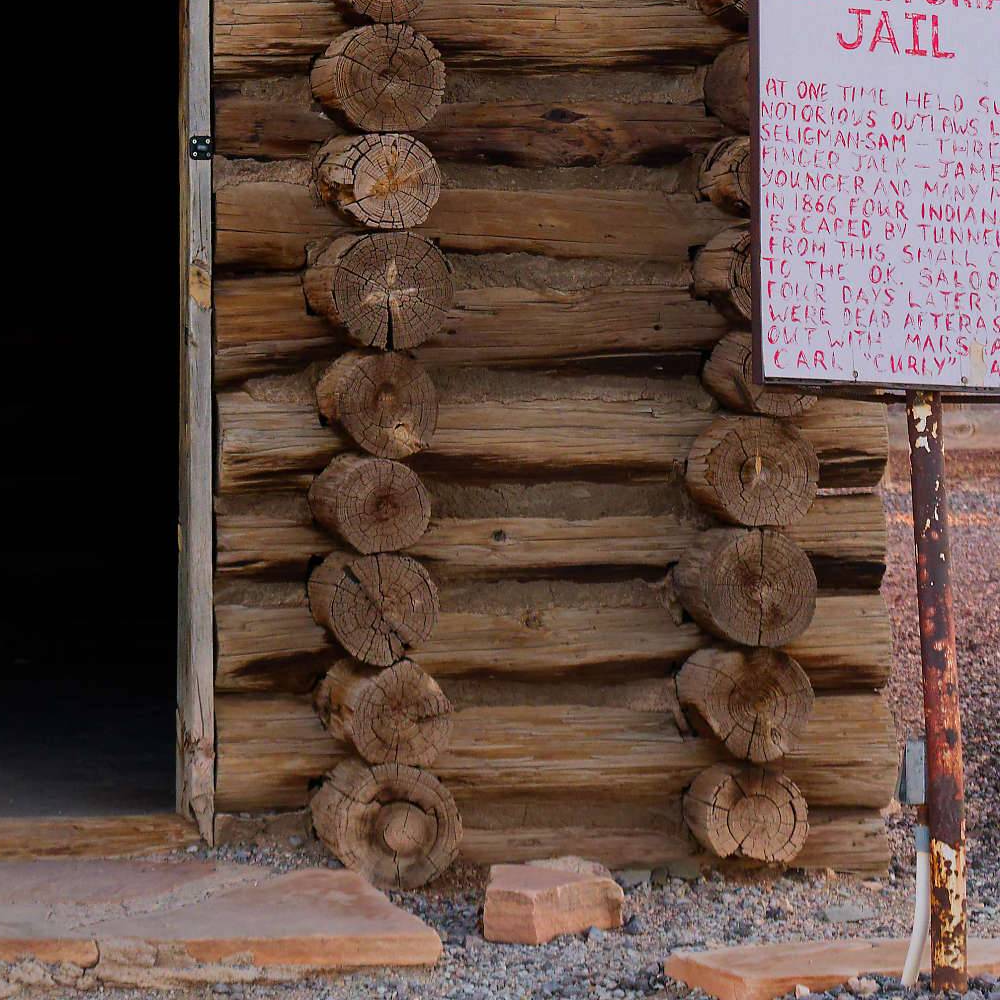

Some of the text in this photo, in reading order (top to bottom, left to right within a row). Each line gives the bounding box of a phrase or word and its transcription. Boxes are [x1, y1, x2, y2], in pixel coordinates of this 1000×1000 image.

[836, 8, 955, 59] JAIL
[766, 78, 788, 98] AT
[797, 80, 828, 102] ONE
[838, 84, 888, 106] TIME
[905, 91, 963, 113] HELD
[761, 101, 877, 128] NOTORIOUS
[891, 111, 979, 137] OUTLAWS
[762, 168, 865, 196] YOUNGER
[873, 177, 911, 197] AND
[765, 192, 784, 210] IN
[795, 192, 836, 215] 1866
[850, 198, 909, 220] FOUR
[769, 213, 872, 239] ESCAPED
[885, 221, 907, 240] BY
[769, 236, 825, 257] FROM
[835, 239, 886, 261] THIS
[903, 244, 976, 268] SMALL
[762, 257, 791, 279] TO
[805, 260, 847, 281] THE
[767, 280, 826, 303] FOUR
[842, 285, 895, 306] DAYS
[908, 291, 982, 312] LATER
[769, 303, 831, 326] WERE
[844, 307, 891, 328] DEAD
[768, 325, 816, 345] OUT
[827, 328, 881, 348] WITH
[774, 349, 843, 371] CARL
